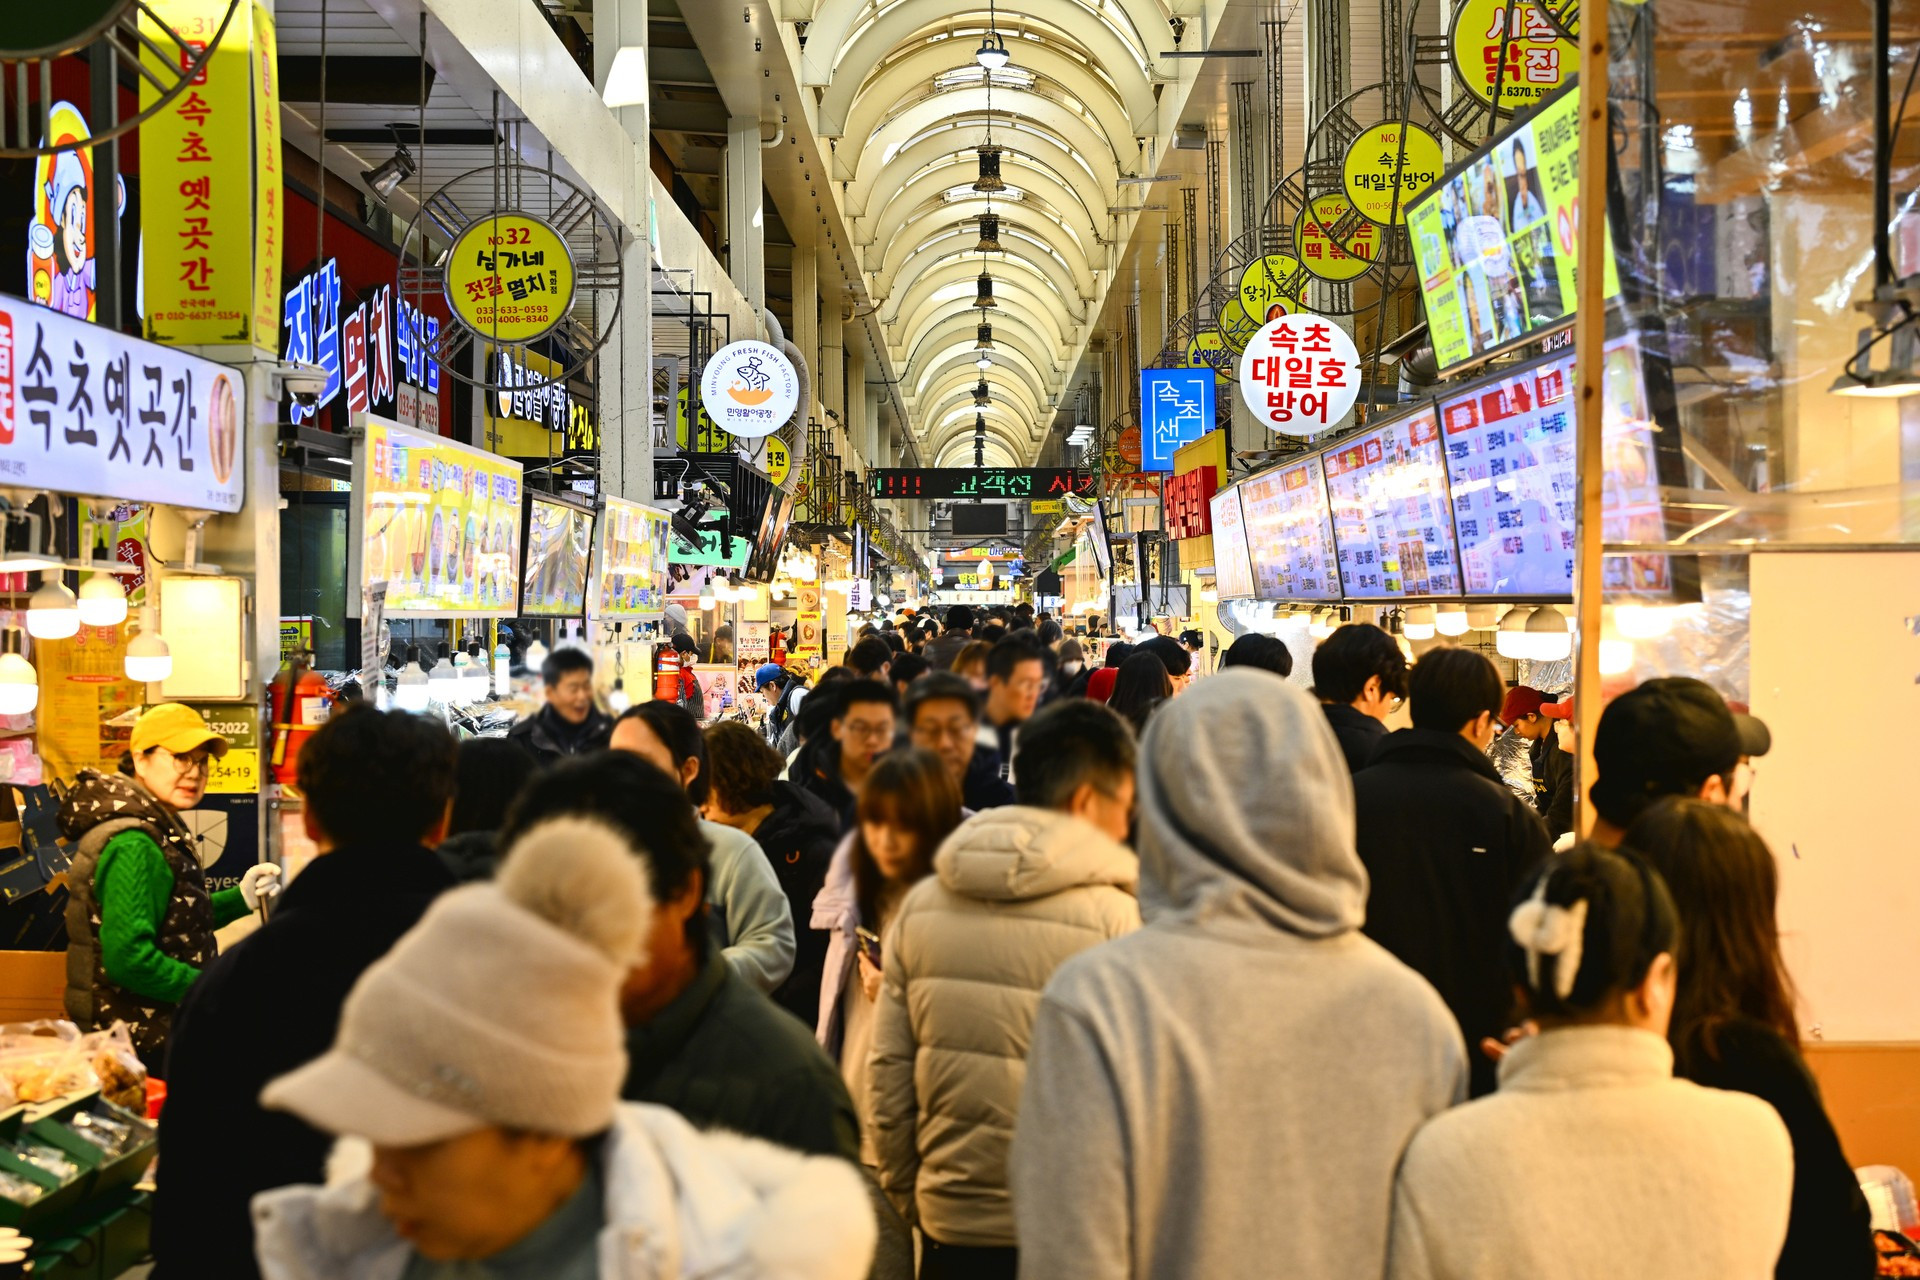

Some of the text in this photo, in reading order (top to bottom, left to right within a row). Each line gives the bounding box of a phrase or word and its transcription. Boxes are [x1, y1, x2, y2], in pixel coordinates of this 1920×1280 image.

[193, 17, 215, 35] 31
[1381, 134, 1407, 144] NO.
[1354, 171, 1435, 191] 대일호방어
[487, 227, 531, 246] NO 32
[476, 250, 544, 271] 심가네
[465, 274, 504, 302] 젓갈
[507, 272, 546, 301] 멸치
[476, 305, 549, 315] 033-633-0593
[476, 314, 549, 324] 010-4006-8340
[1268, 322, 1332, 355] 속초
[343, 284, 394, 428] 멸치
[711, 347, 792, 400] MINYOUNG FRESH FISH FACTORY
[1252, 356, 1348, 389] 대일호
[399, 393, 438, 427] 033-63-0593
[726, 408, 773, 419] 민영활어공장
[1267, 391, 1329, 424] 방어
